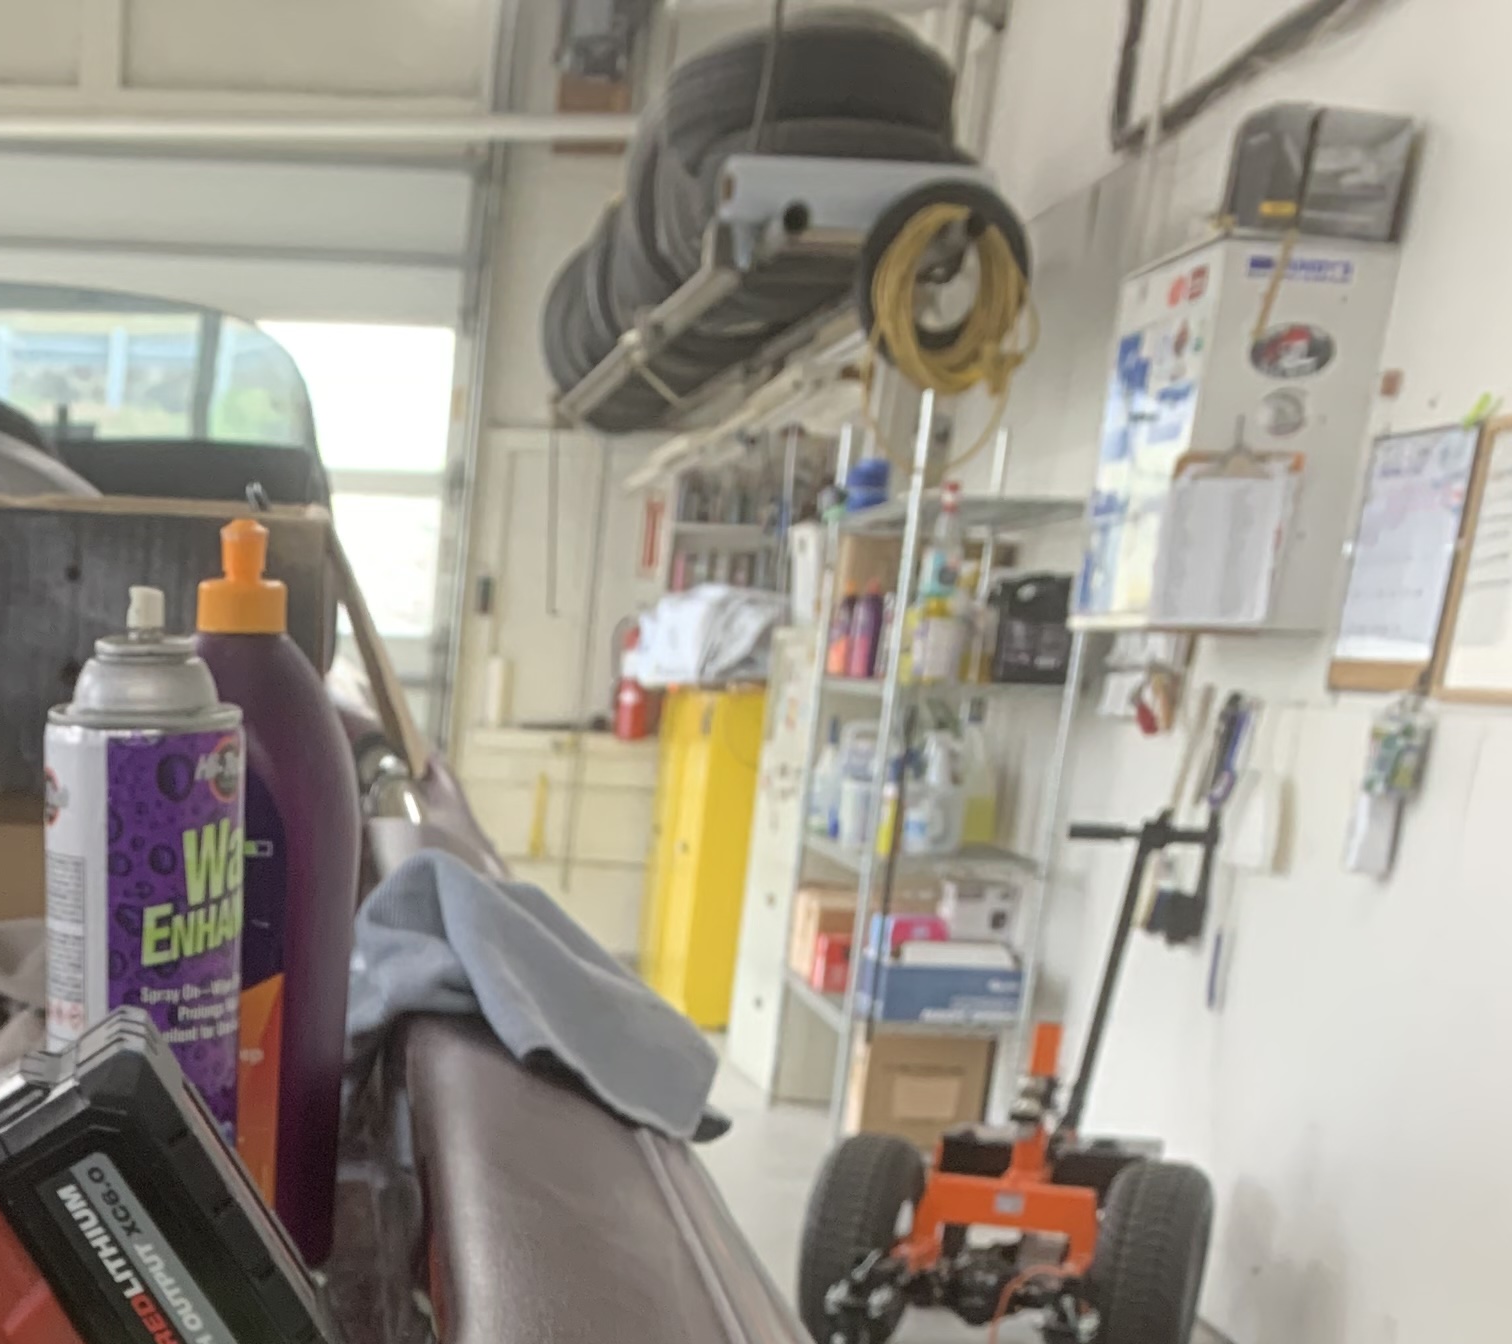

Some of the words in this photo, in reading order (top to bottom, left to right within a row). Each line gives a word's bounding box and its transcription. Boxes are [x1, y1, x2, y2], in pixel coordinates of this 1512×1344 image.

[140, 985, 181, 1006] Spray
[87, 1166, 144, 1238] XC6.0
[133, 1243, 203, 1332] OUTPUT
